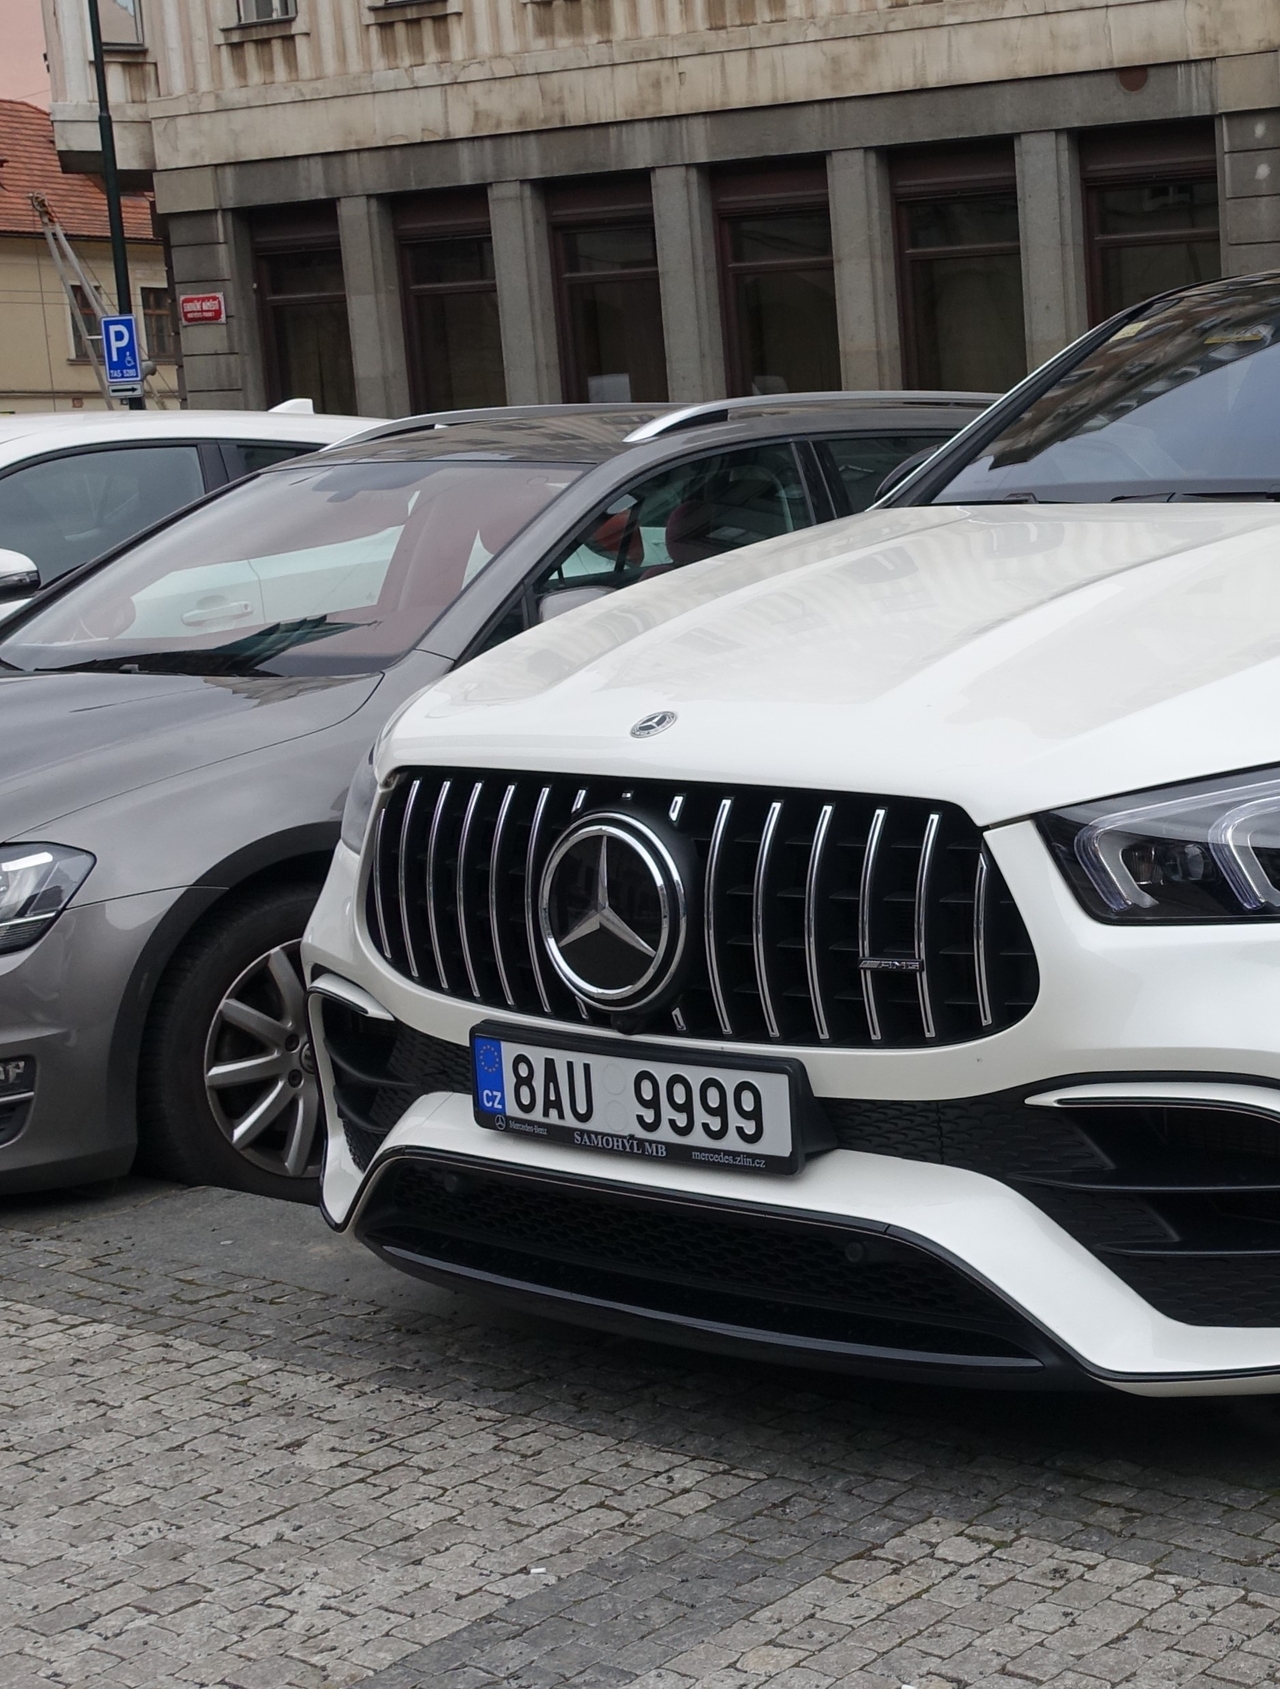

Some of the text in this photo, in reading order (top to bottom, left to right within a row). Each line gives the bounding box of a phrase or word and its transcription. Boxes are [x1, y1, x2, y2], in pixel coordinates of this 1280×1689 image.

[109, 324, 130, 362] P
[110, 369, 122, 378] TAS
[483, 1089, 503, 1109] CZ
[512, 1053, 764, 1144] 8AU 9999
[509, 1120, 548, 1136] Mercedes-Benz
[574, 1131, 667, 1158] SAMOHÝL MB
[691, 1150, 766, 1169] mercedes.zlin.cz
